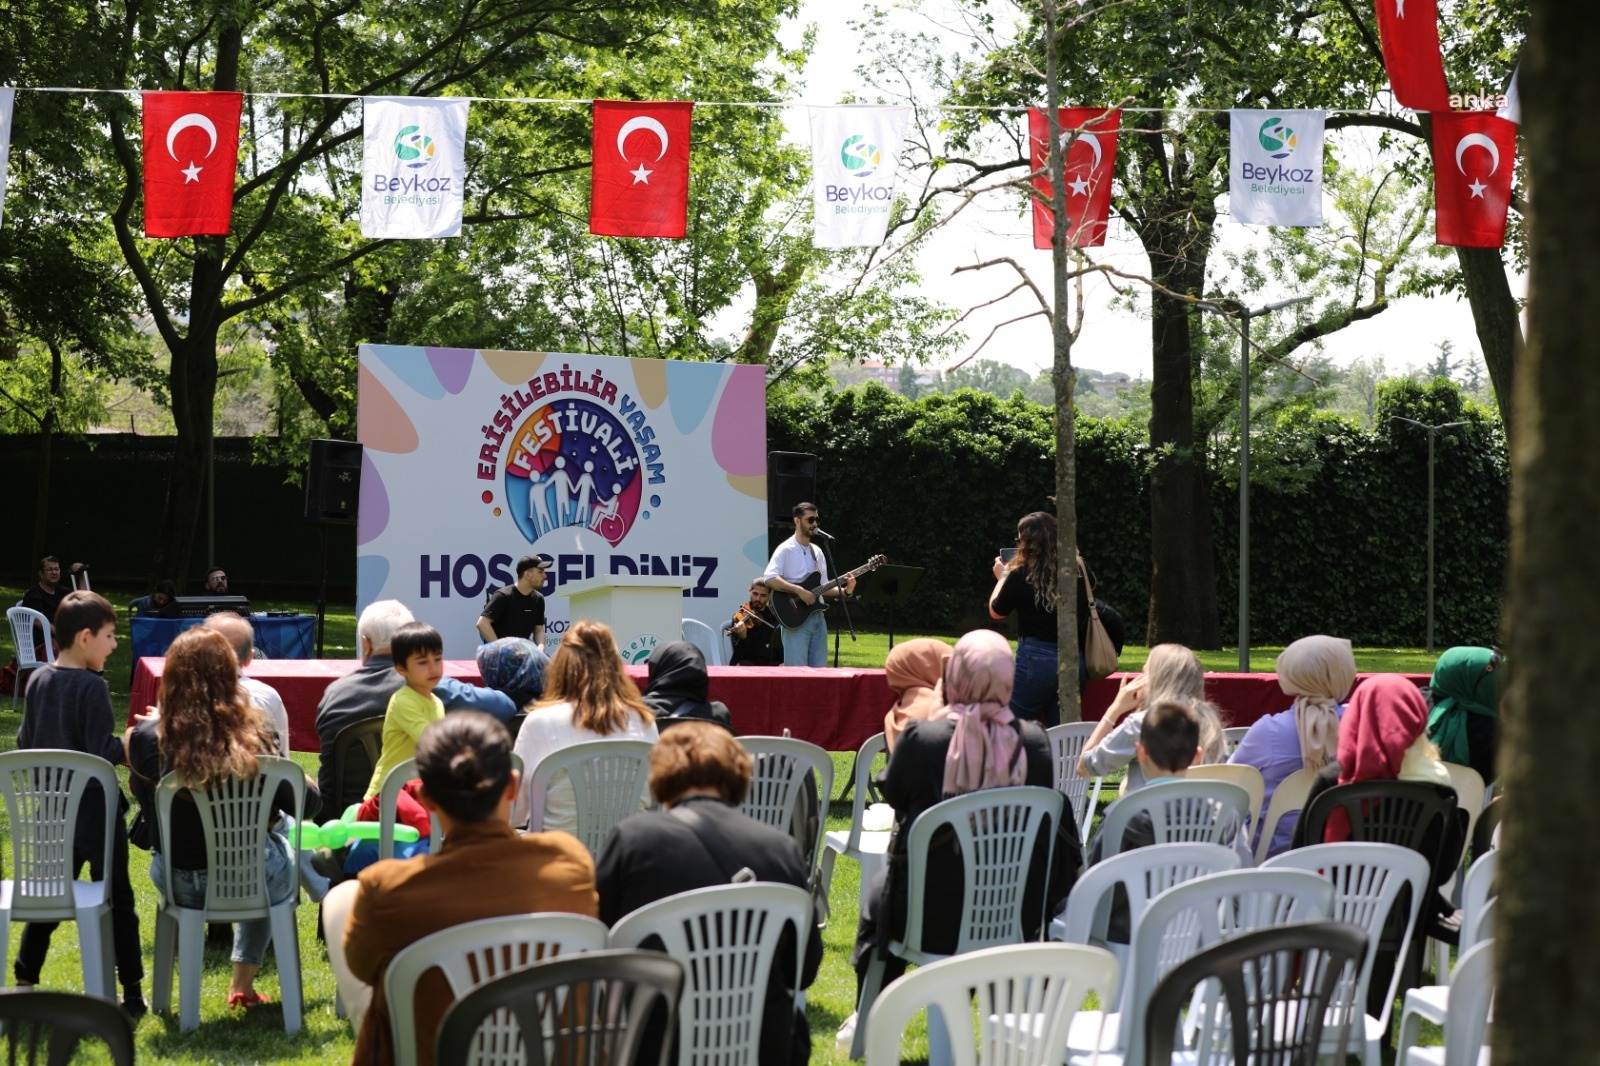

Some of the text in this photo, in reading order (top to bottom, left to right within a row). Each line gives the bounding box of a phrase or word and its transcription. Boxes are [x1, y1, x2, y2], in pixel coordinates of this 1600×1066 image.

[1242, 162, 1314, 185] Beykoz
[373, 174, 451, 195] Beykoz
[1251, 183, 1305, 196] Belediyesi
[383, 195, 441, 207] Belediyesi
[835, 204, 888, 215] Belediyesi
[477, 363, 666, 485] ERİŞİLEBİLİR YAŞAM
[513, 402, 640, 475] FESTİVALİ
